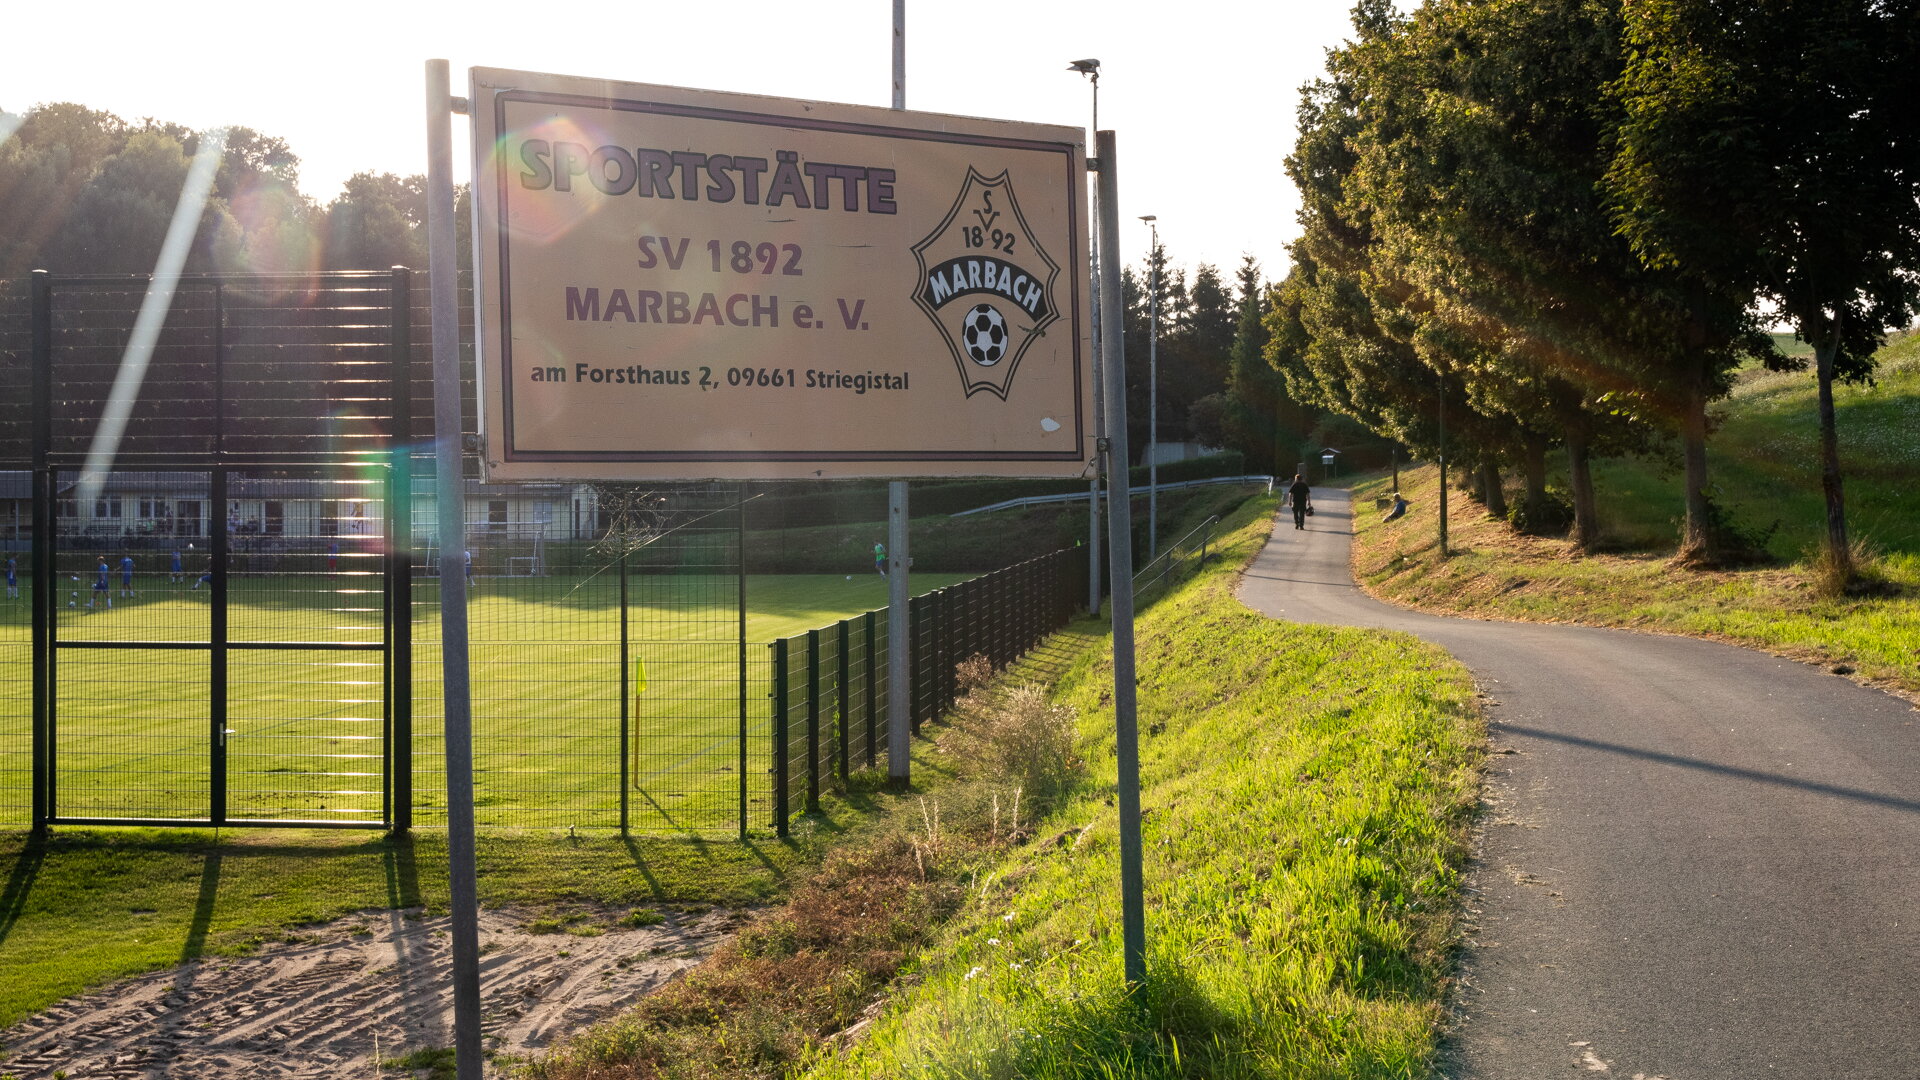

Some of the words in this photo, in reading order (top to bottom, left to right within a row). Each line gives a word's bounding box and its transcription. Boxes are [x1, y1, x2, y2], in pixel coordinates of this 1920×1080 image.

[520, 138, 898, 215] SPORTSTÄTTE
[637, 235, 690, 271] SV
[707, 239, 804, 276] 1892
[565, 286, 779, 328] MARBACH
[792, 303, 824, 329] e.
[836, 298, 870, 331] V.
[929, 260, 1042, 313] MARBACH
[530, 365, 567, 383] am
[575, 363, 691, 386] Forsthaus
[699, 366, 720, 389] 2,
[727, 367, 796, 388] 09661
[805, 369, 910, 394] Striegistal
